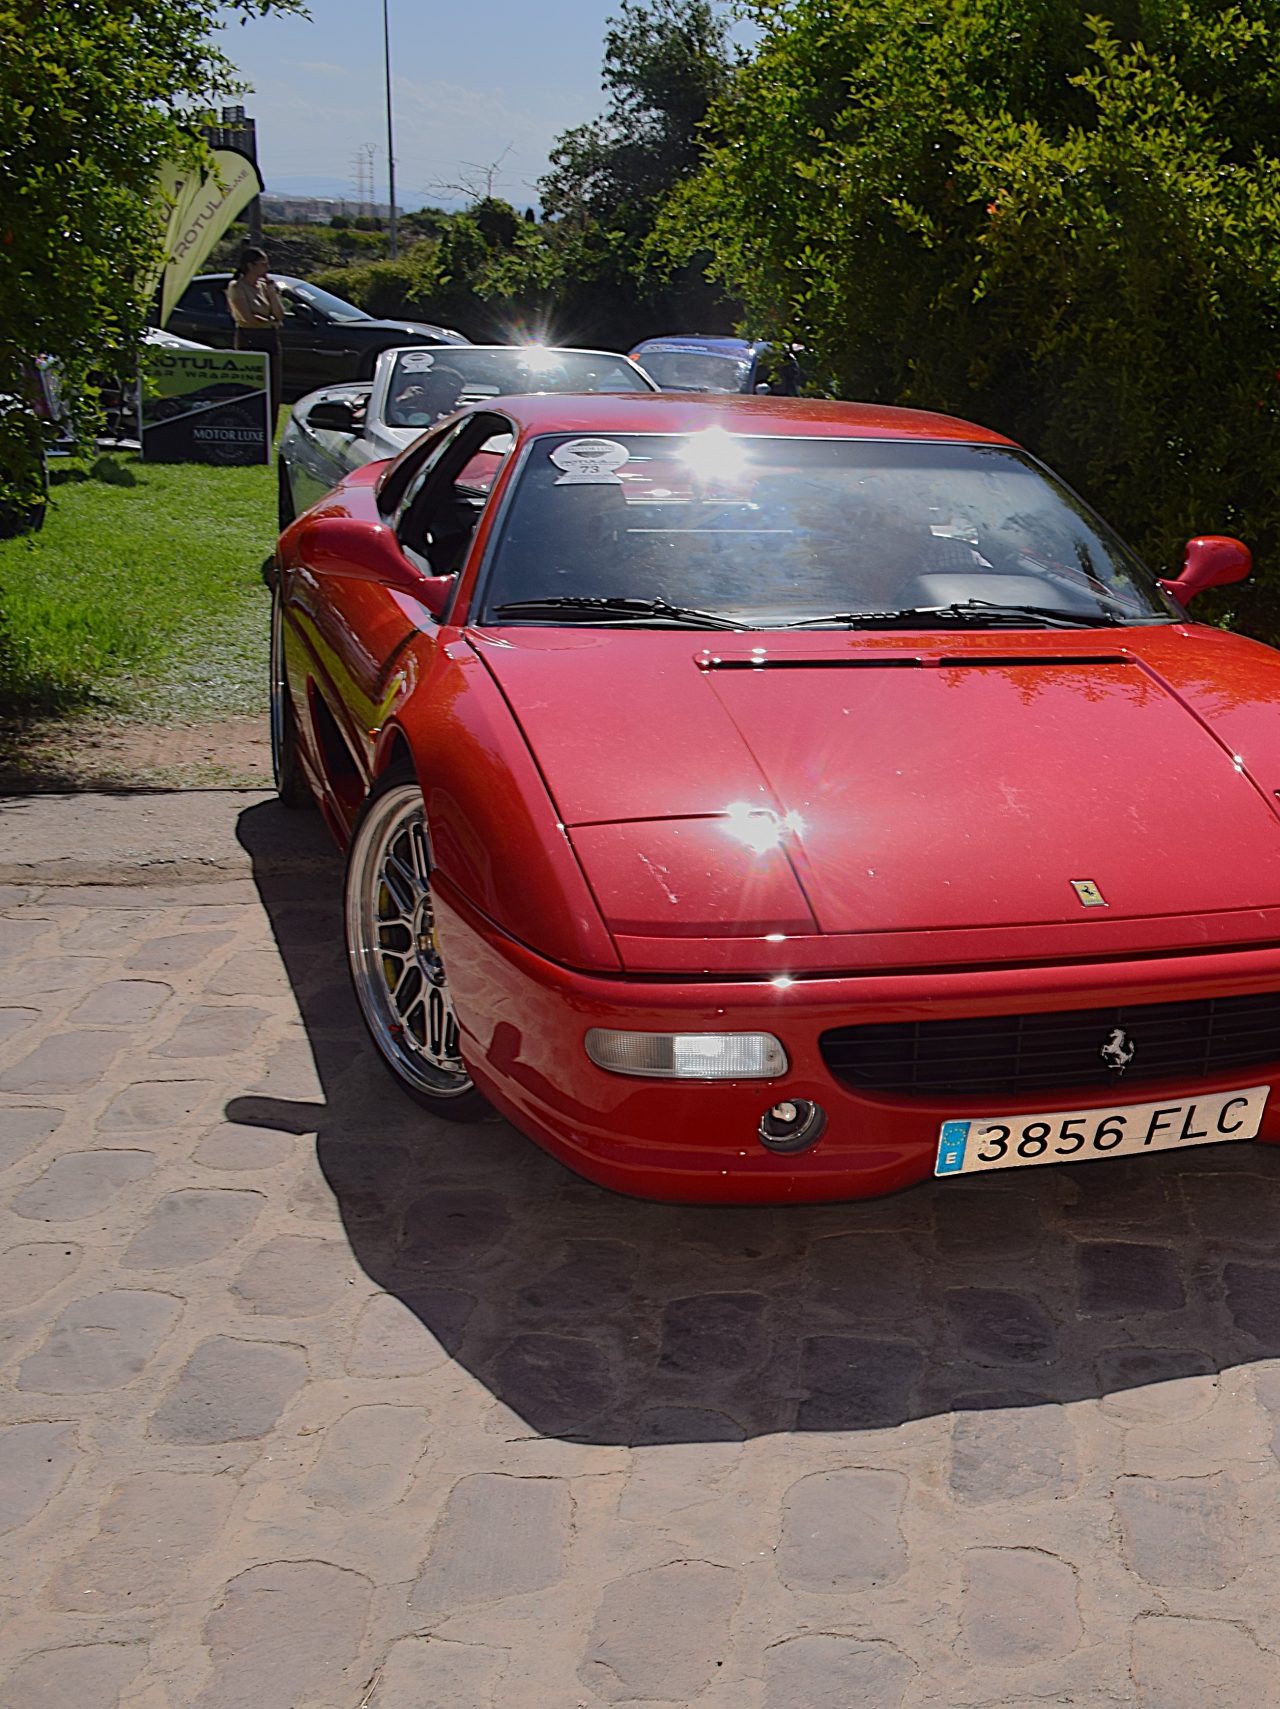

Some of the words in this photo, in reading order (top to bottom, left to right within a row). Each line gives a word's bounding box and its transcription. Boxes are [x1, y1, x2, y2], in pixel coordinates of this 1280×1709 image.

[149, 355, 264, 373] OTULA.ME
[184, 371, 265, 381] WRAPPING
[193, 429, 236, 440] MOTOR
[237, 431, 265, 441] LUXE
[580, 465, 600, 474] 73
[945, 1152, 957, 1165] E
[977, 1115, 1127, 1162] 3856
[1144, 1097, 1249, 1146] FLC
